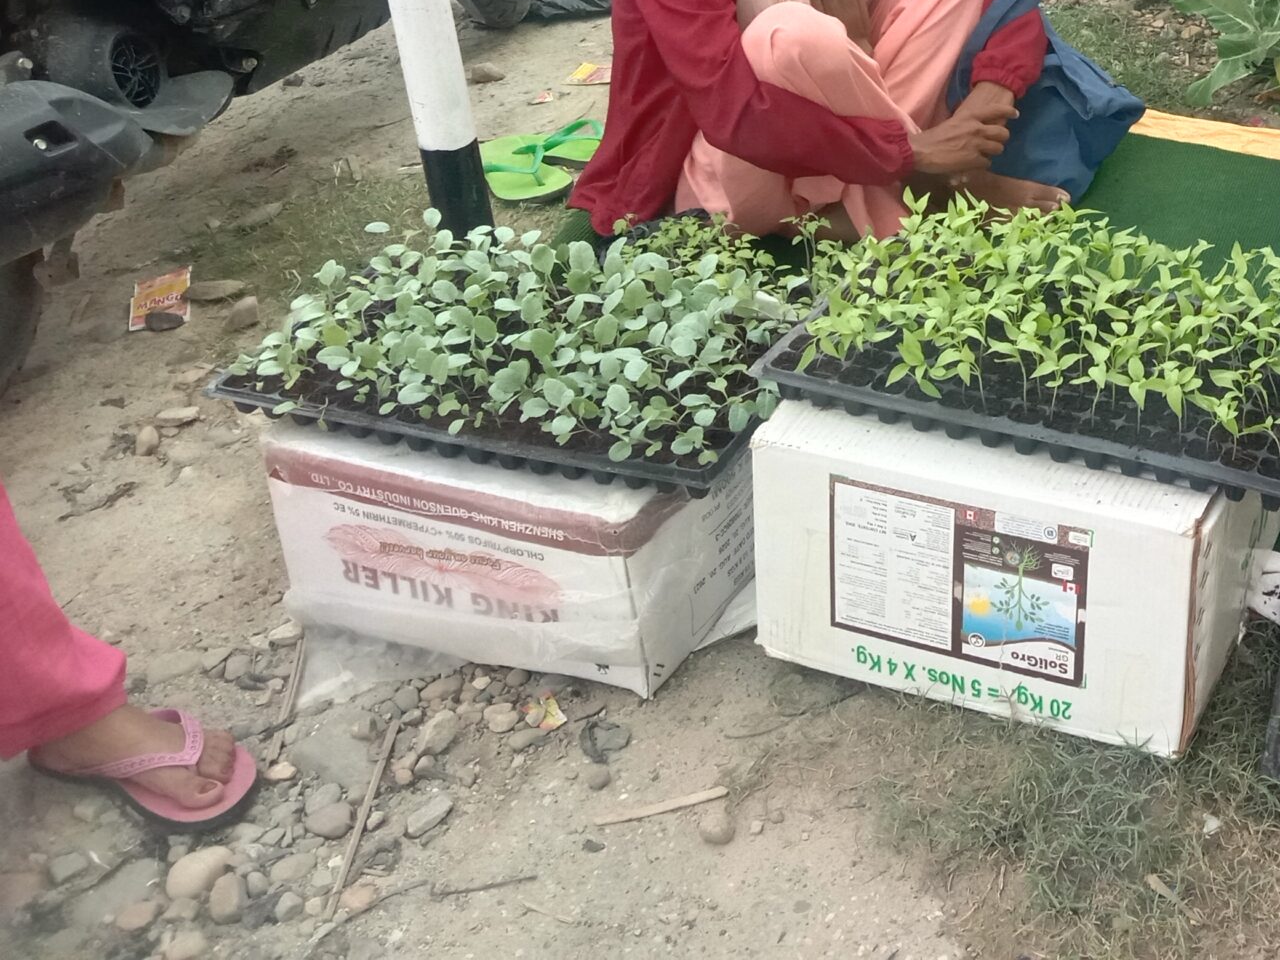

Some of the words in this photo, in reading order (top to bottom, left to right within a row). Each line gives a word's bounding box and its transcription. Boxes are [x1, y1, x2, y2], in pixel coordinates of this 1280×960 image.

[353, 482, 411, 505] INDUSTRY
[331, 501, 347, 512] EC
[471, 510, 498, 526] KING
[498, 516, 565, 541] SHENZHEN
[467, 533, 545, 561] CHLORPYRIFOS
[339, 558, 455, 608] KILLER
[469, 590, 561, 625] KING
[847, 643, 885, 672] Kg.
[884, 658, 898, 675] 4
[1010, 650, 1069, 675] SoliGro
[1054, 652, 1068, 661] GR
[899, 661, 918, 681] X
[918, 665, 967, 691] Nos.
[967, 678, 983, 698] 5
[1047, 697, 1074, 720] 20
